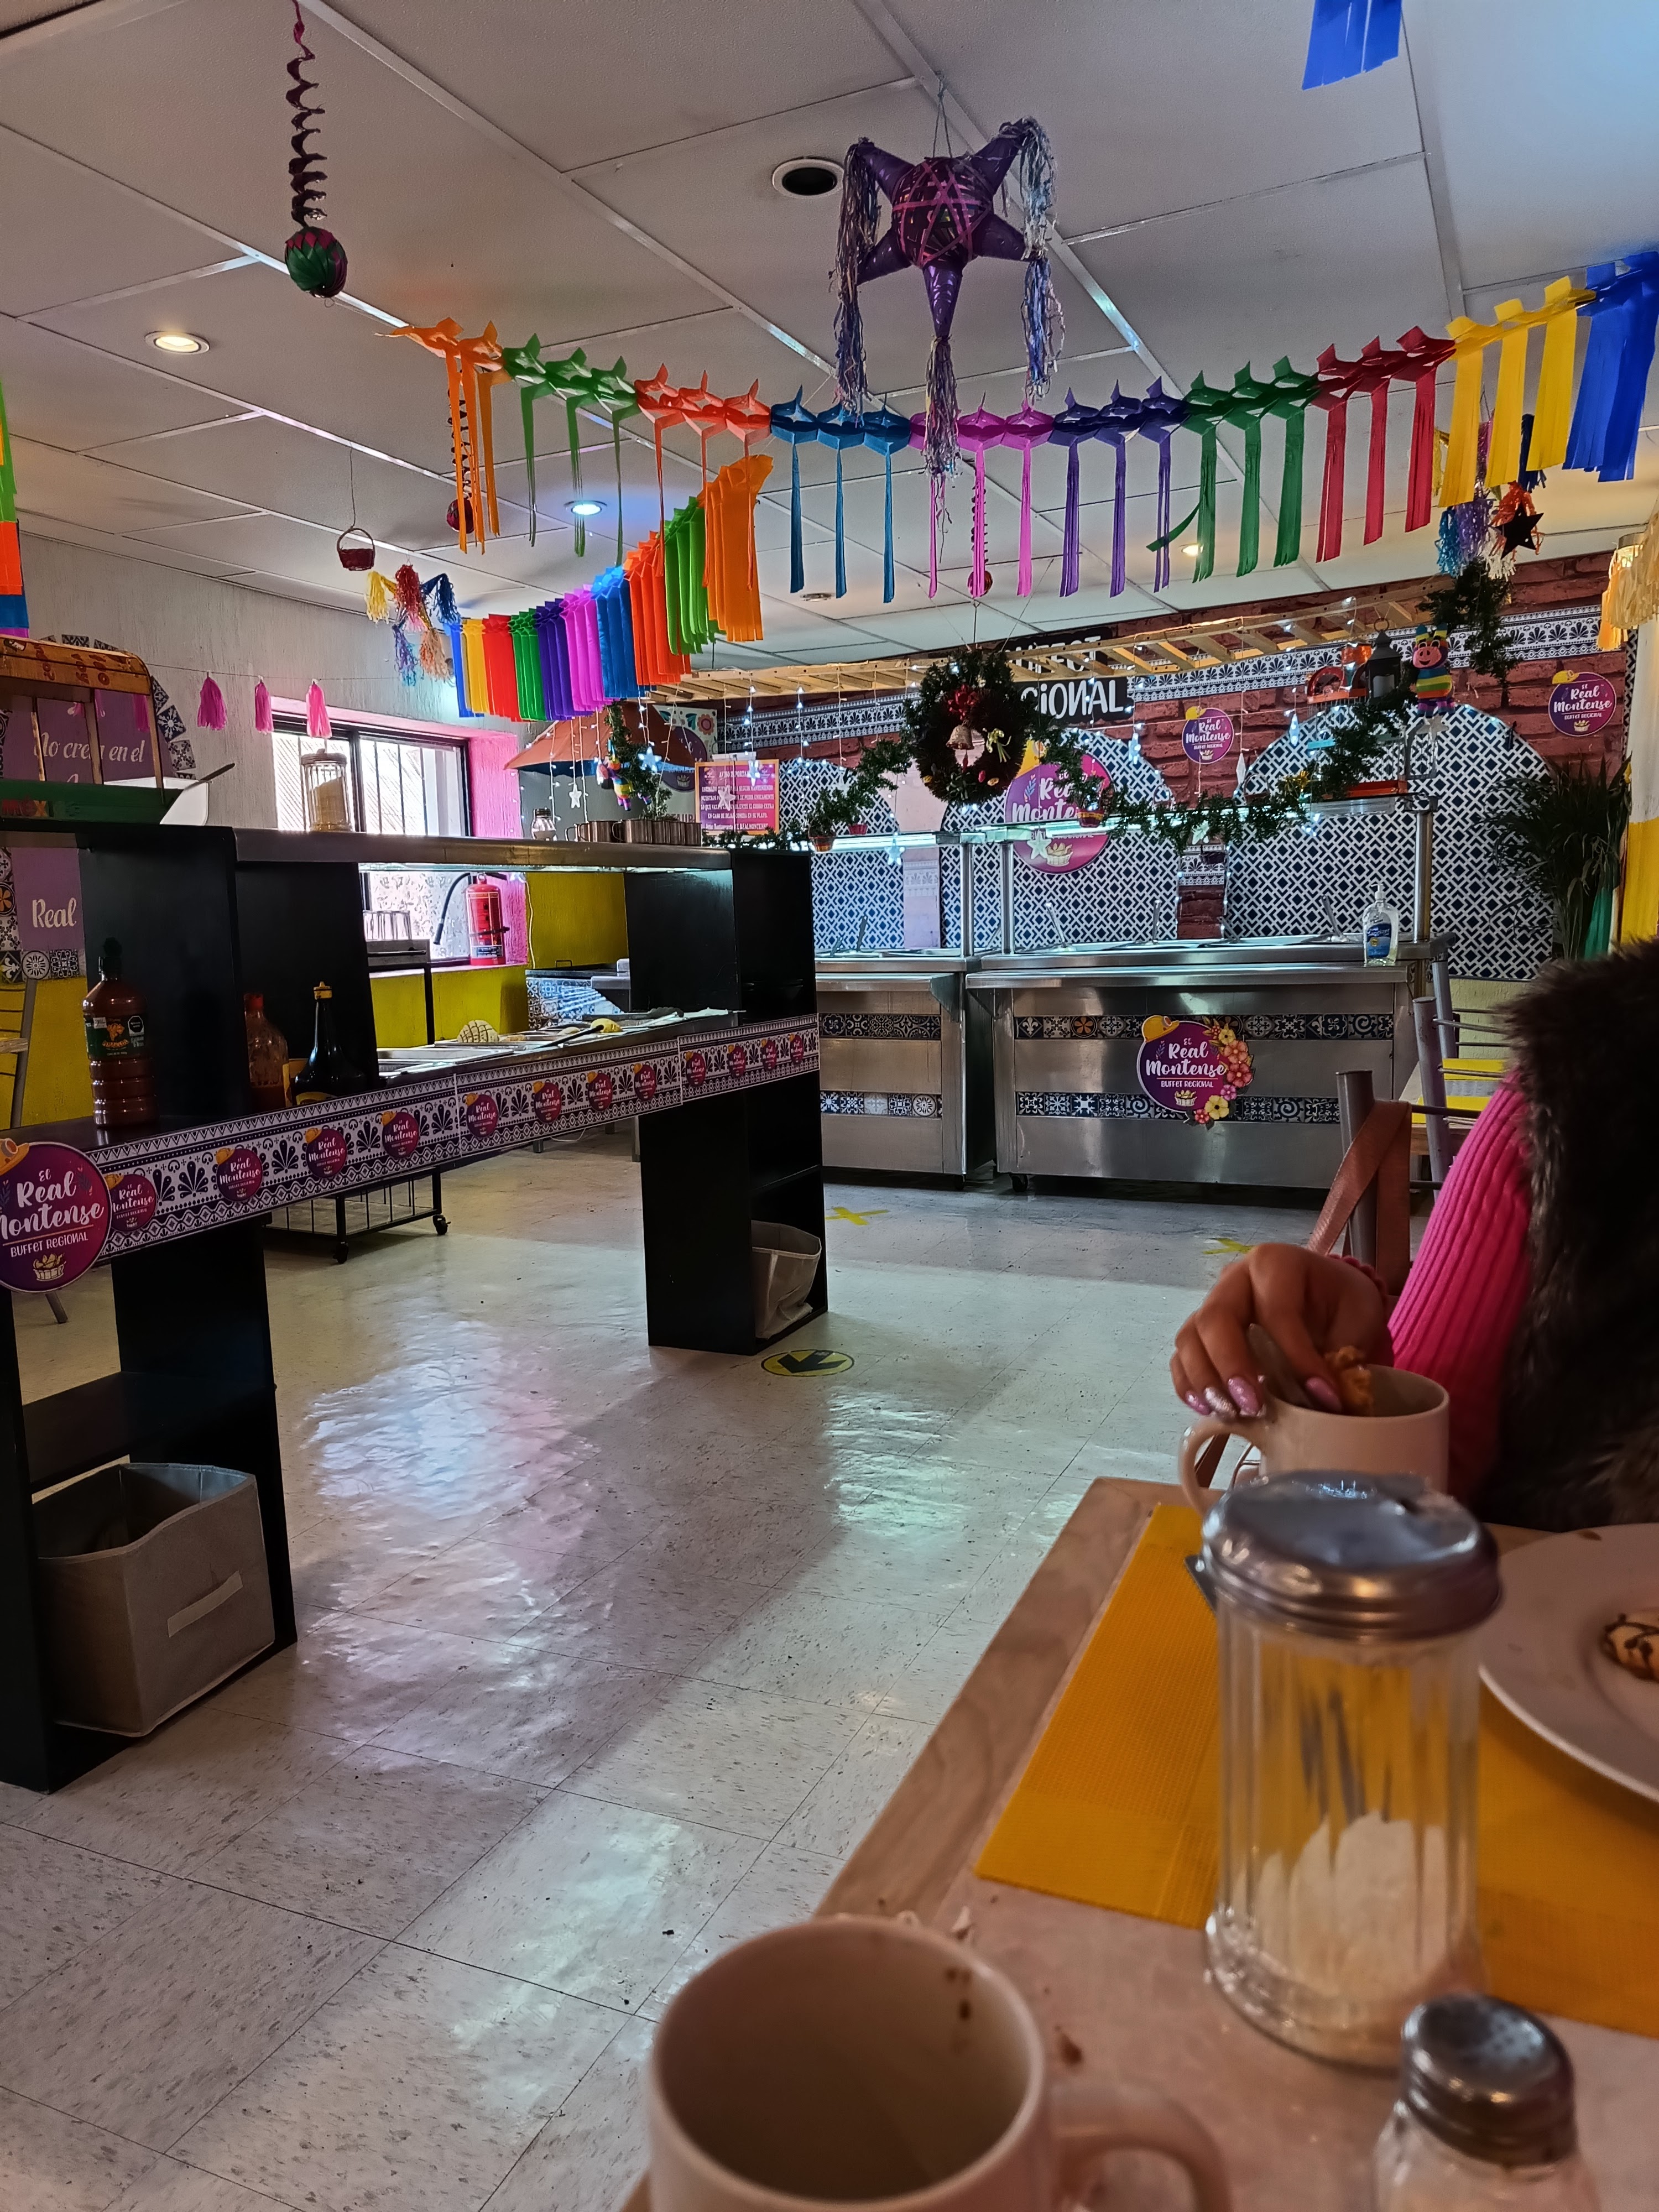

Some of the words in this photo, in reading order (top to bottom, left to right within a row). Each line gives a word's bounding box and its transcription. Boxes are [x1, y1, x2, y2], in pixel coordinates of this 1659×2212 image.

[1571, 685, 1600, 700] Real
[1553, 698, 1613, 713] Montense
[1198, 719, 1222, 733] Real
[1185, 731, 1232, 744] Montense
[109, 745, 128, 762] en
[131, 739, 145, 763] el
[32, 898, 77, 928] Real
[1168, 1041, 1209, 1060] Real
[1145, 1058, 1229, 1078] Montense
[318, 1137, 337, 1151] Real
[309, 1147, 346, 1162] Montense
[230, 1157, 251, 1172] Real
[38, 1168, 52, 1182] El
[220, 1168, 261, 1185] Montense
[17, 1171, 77, 1208] Real
[119, 1184, 143, 1200] Real
